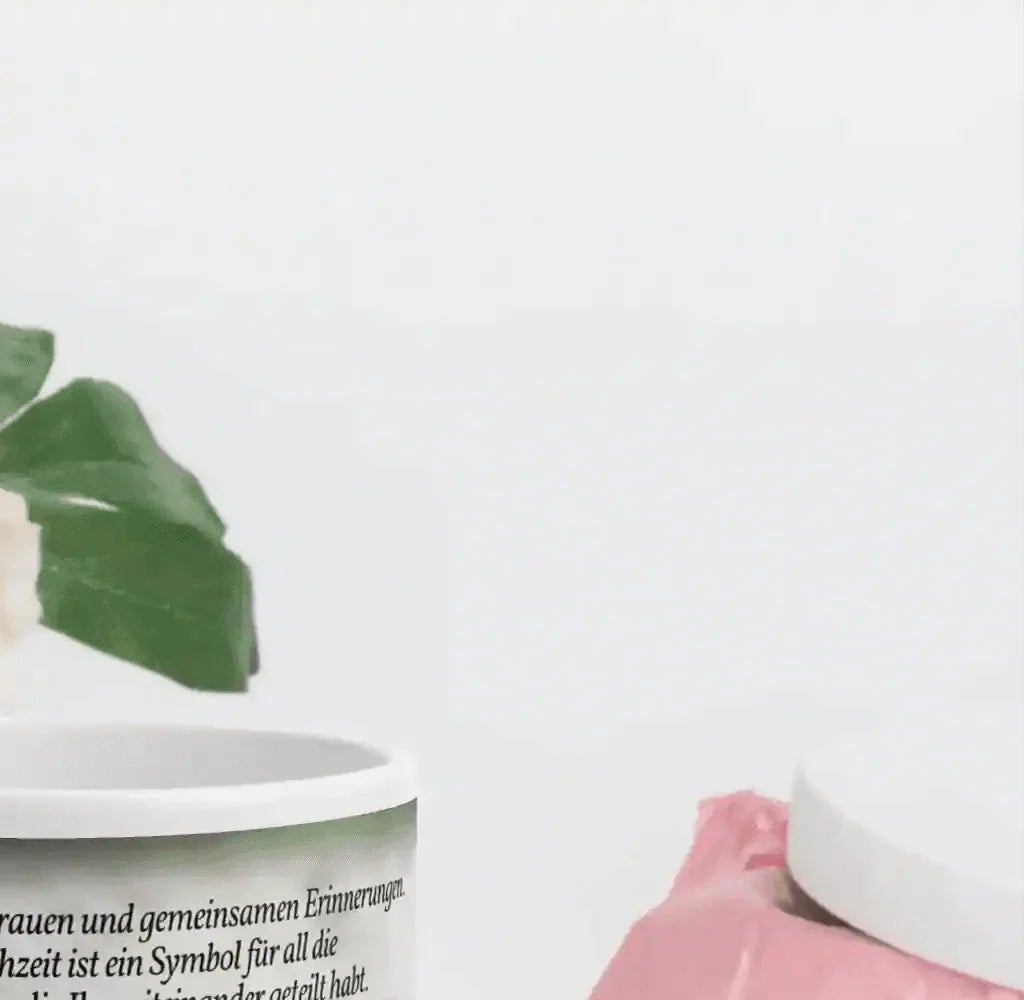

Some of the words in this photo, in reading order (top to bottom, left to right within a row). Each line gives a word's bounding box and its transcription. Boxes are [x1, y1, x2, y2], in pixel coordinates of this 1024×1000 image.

[81, 902, 135, 935] und
[137, 899, 300, 944] gemeinsamen
[304, 876, 406, 919] Erinnerungen.
[67, 947, 100, 979] ist
[104, 946, 144, 978] ein
[148, 940, 242, 985] Symbol
[241, 936, 280, 980] für
[282, 931, 309, 966] all
[311, 926, 339, 961] die
[328, 964, 370, 1000] habt.
